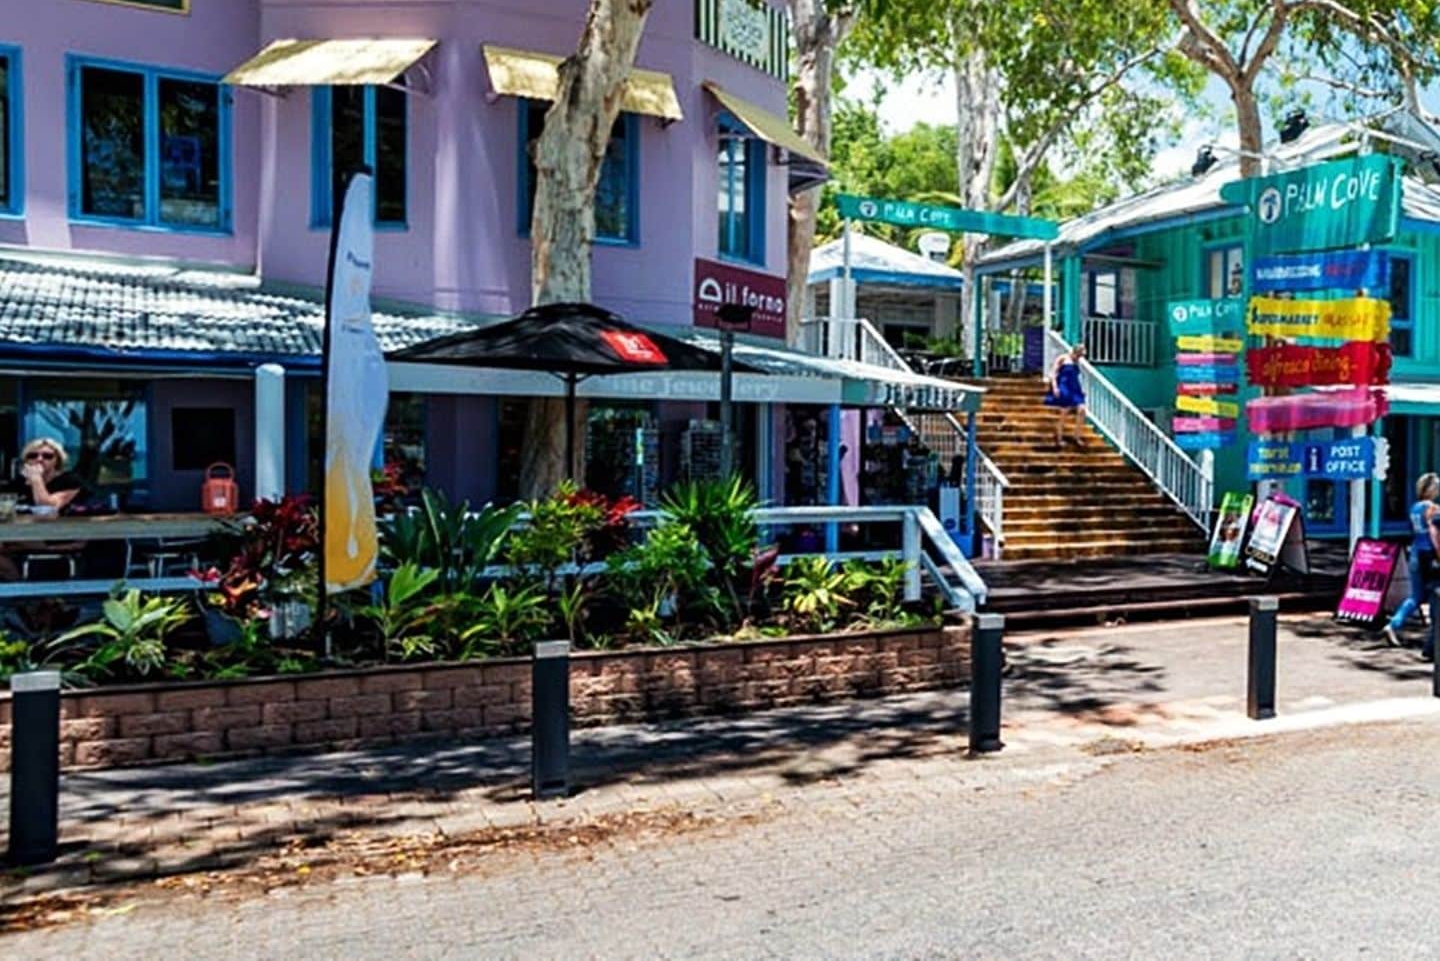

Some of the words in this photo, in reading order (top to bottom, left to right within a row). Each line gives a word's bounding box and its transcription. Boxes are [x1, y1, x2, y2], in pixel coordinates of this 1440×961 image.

[725, 282, 737, 304] il
[743, 286, 784, 313] forno
[1331, 446, 1360, 457] POST
[1326, 460, 1366, 474] OFFICE
